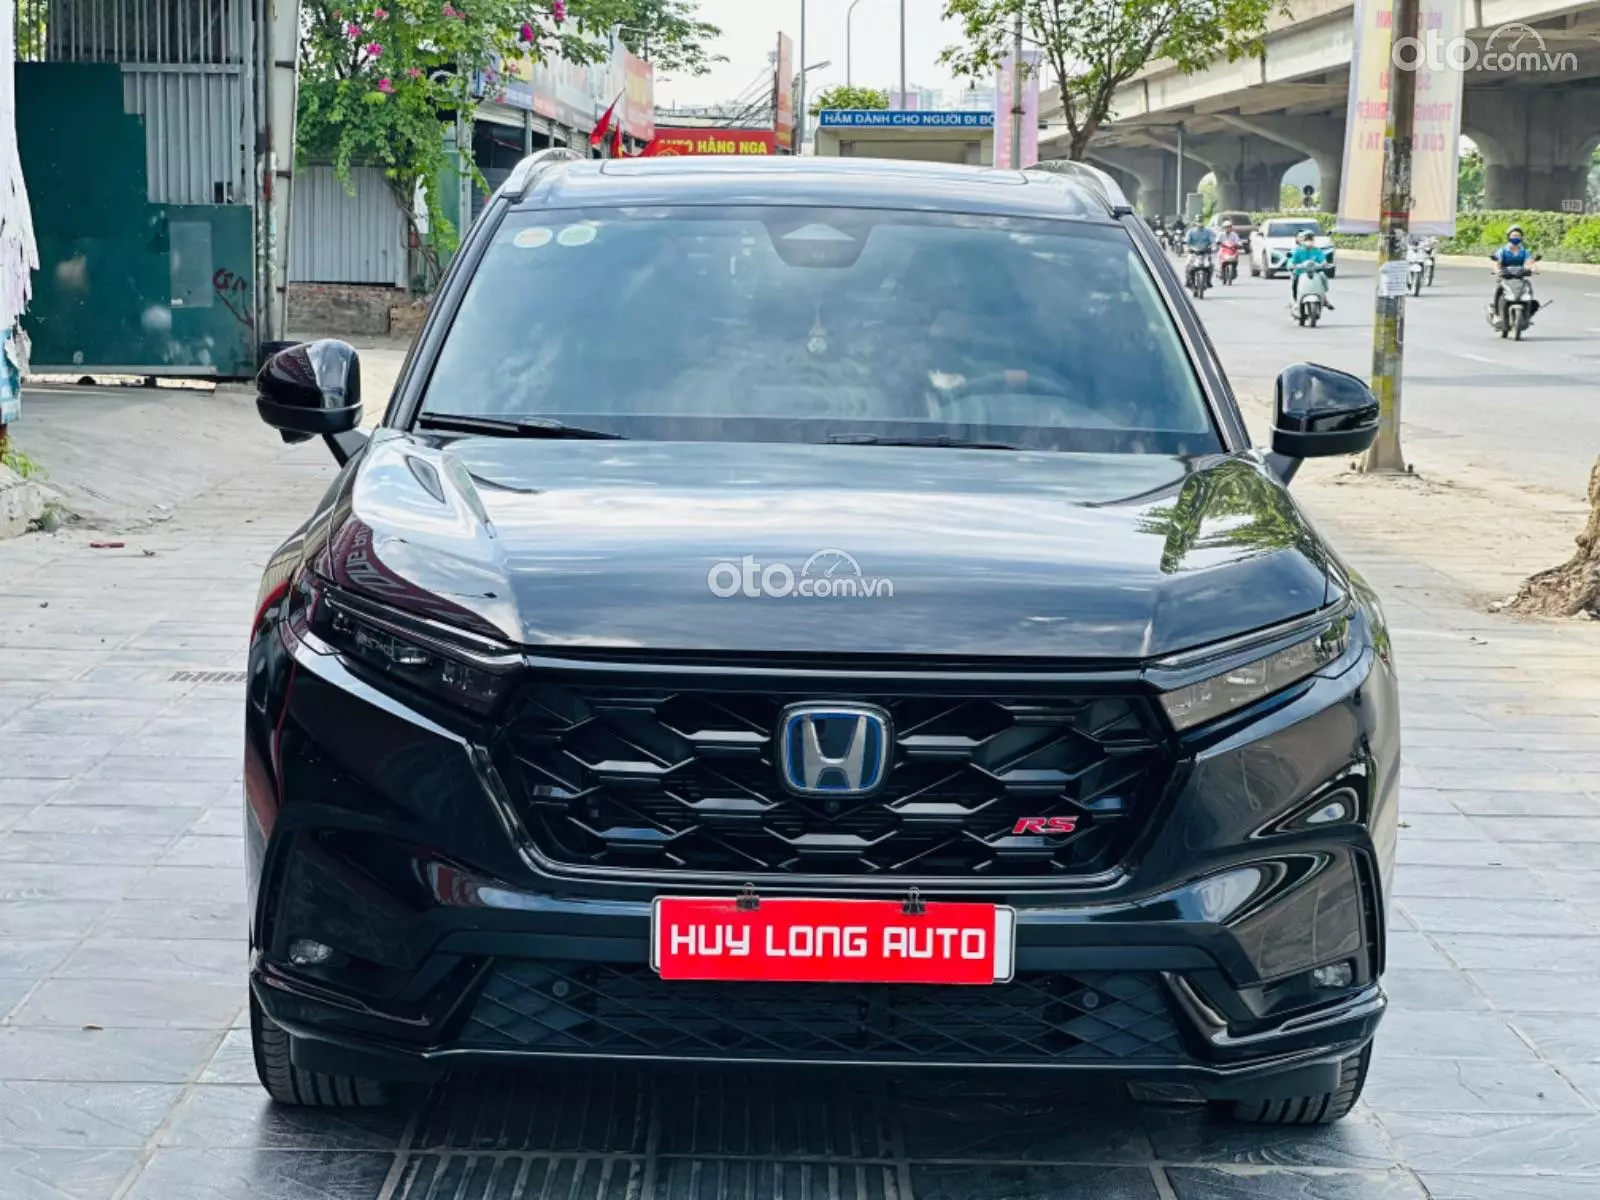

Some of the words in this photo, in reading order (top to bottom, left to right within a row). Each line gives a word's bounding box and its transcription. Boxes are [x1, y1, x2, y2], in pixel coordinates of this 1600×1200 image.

[855, 111, 889, 125] DÀNH
[893, 113, 920, 125] CHO
[964, 113, 977, 125] ĐI
[739, 140, 768, 155] NGA
[1012, 816, 1081, 835] RS
[670, 924, 750, 956] HUY
[766, 925, 868, 958] LONG
[883, 926, 986, 960] AUTO
